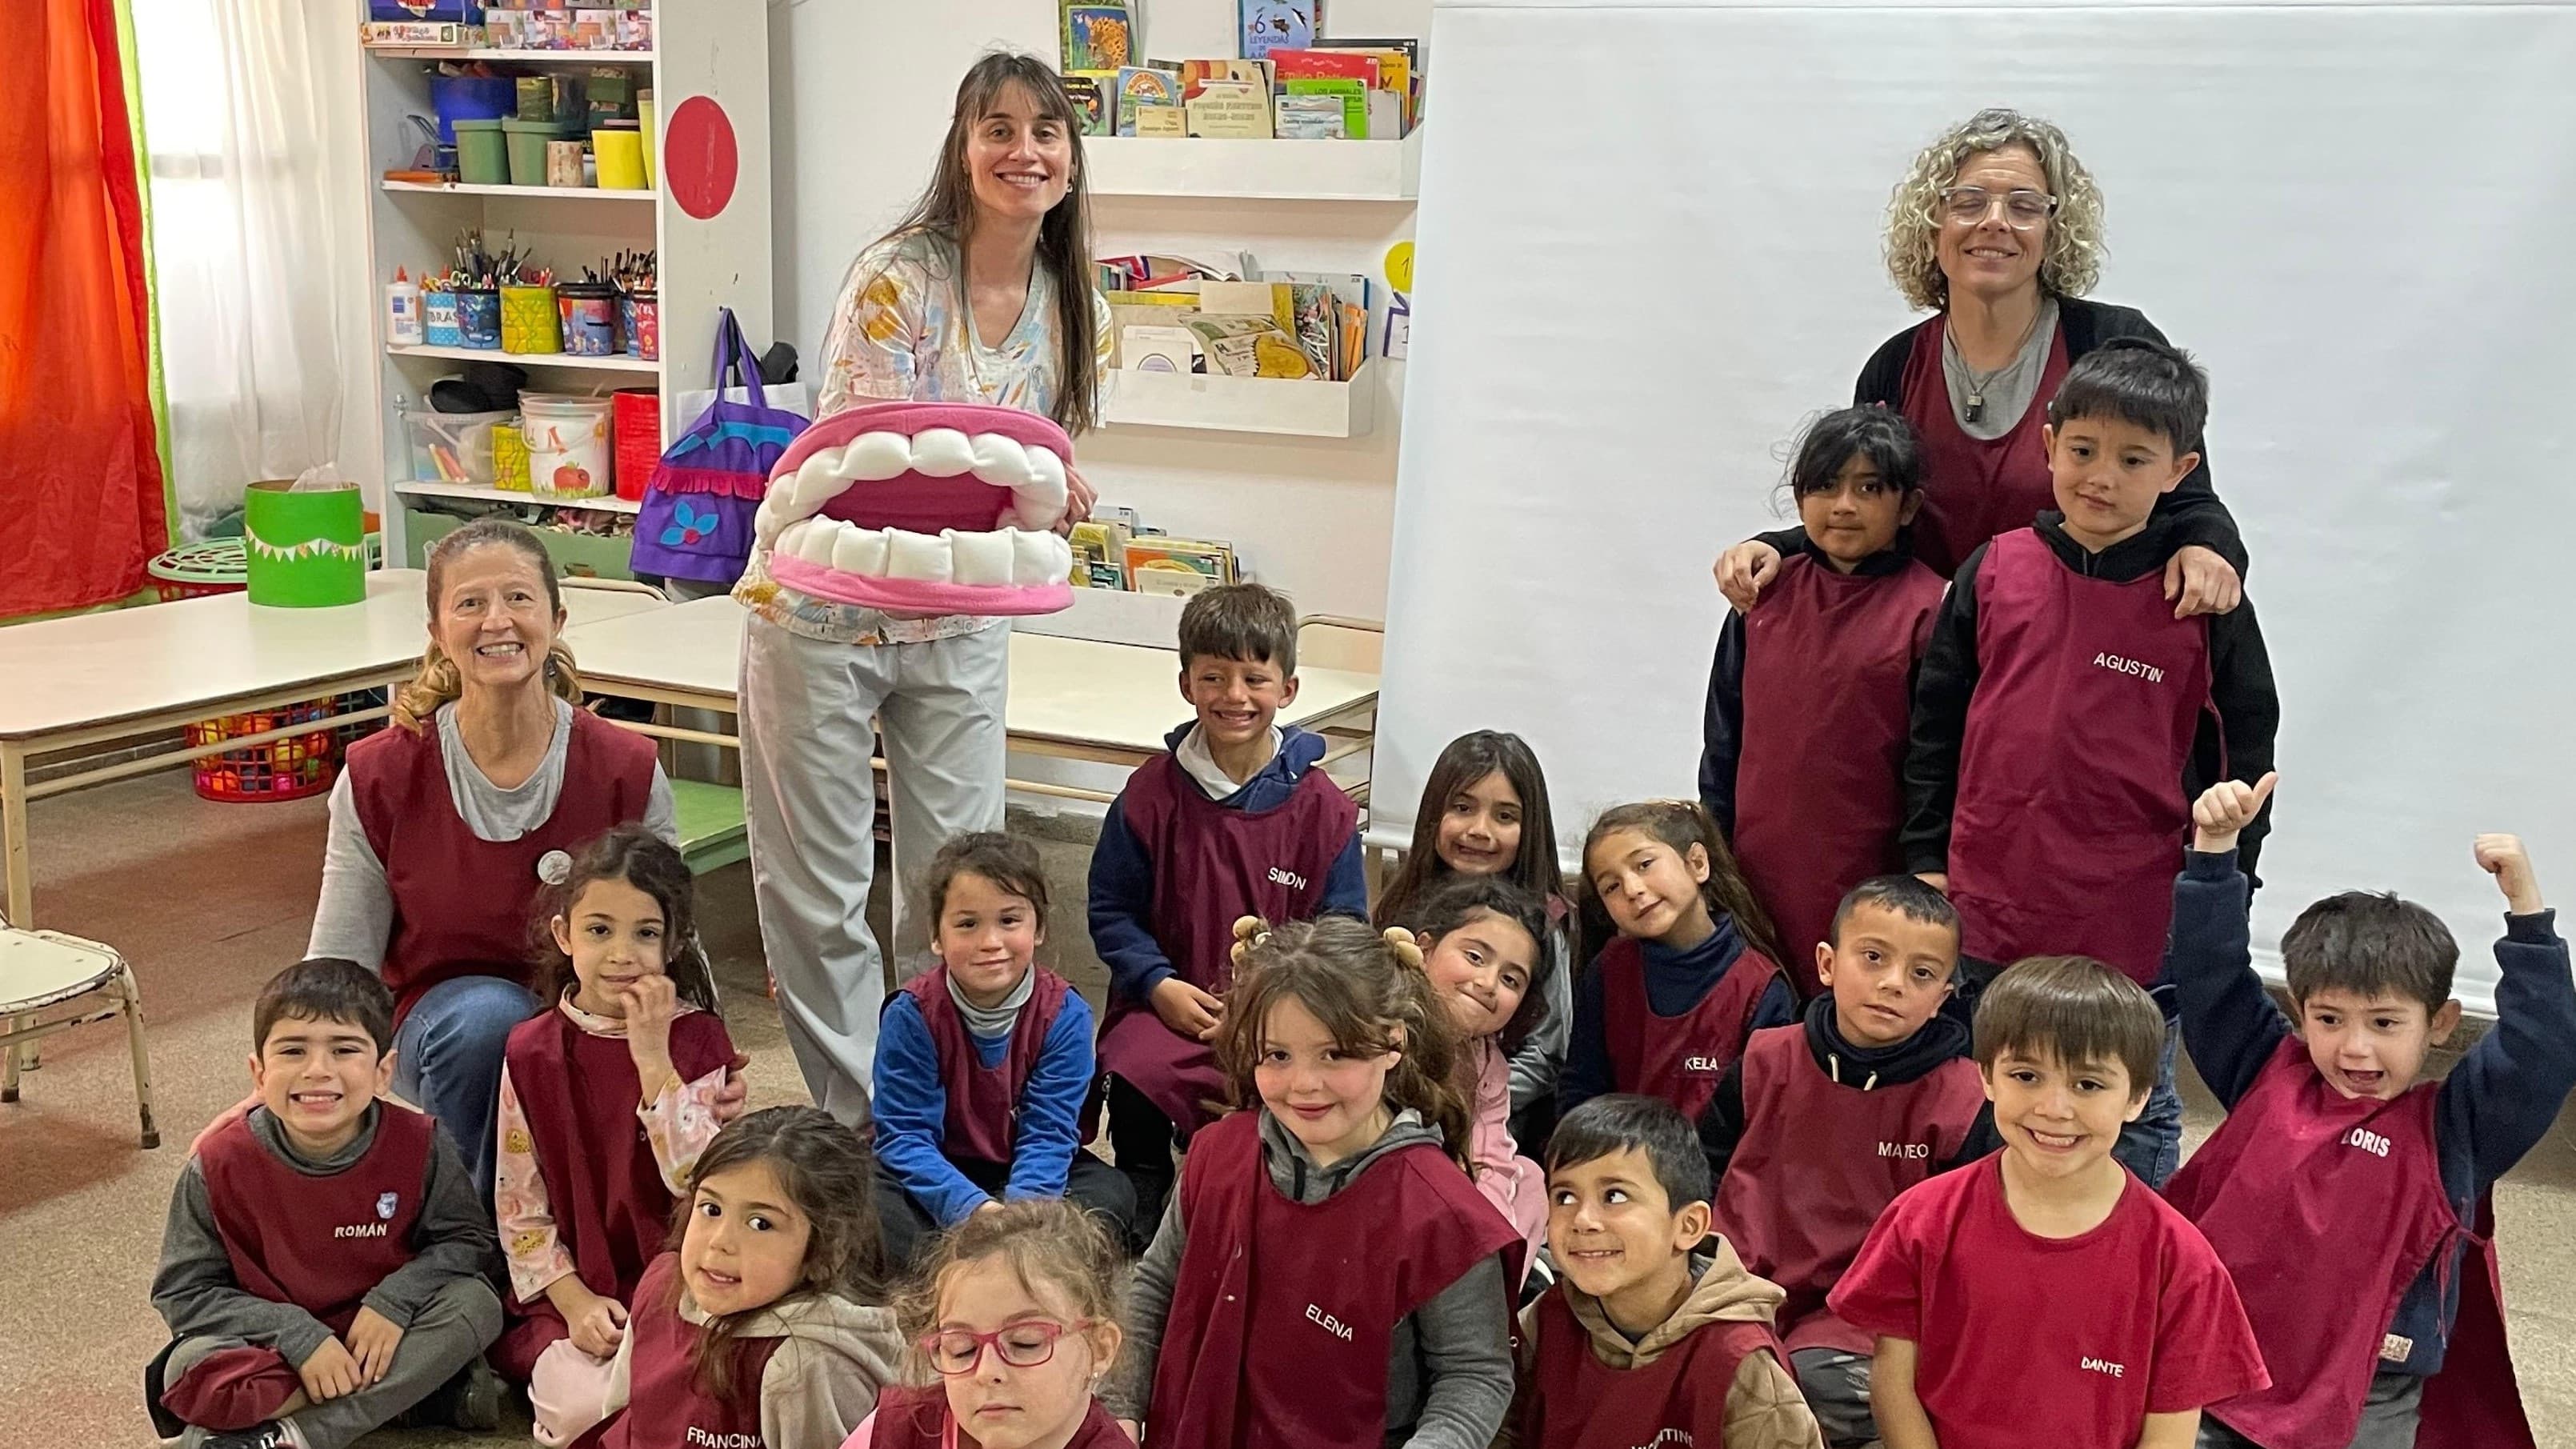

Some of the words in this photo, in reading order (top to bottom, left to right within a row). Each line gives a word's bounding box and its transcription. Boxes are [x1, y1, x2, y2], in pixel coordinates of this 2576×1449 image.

[2093, 651, 2165, 683] AGUSTIN
[1878, 1141, 1930, 1159] MATEO
[334, 1222, 388, 1238] ROMÁN
[1305, 1303, 1354, 1342] ELENA
[2081, 1356, 2125, 1378] DANTE
